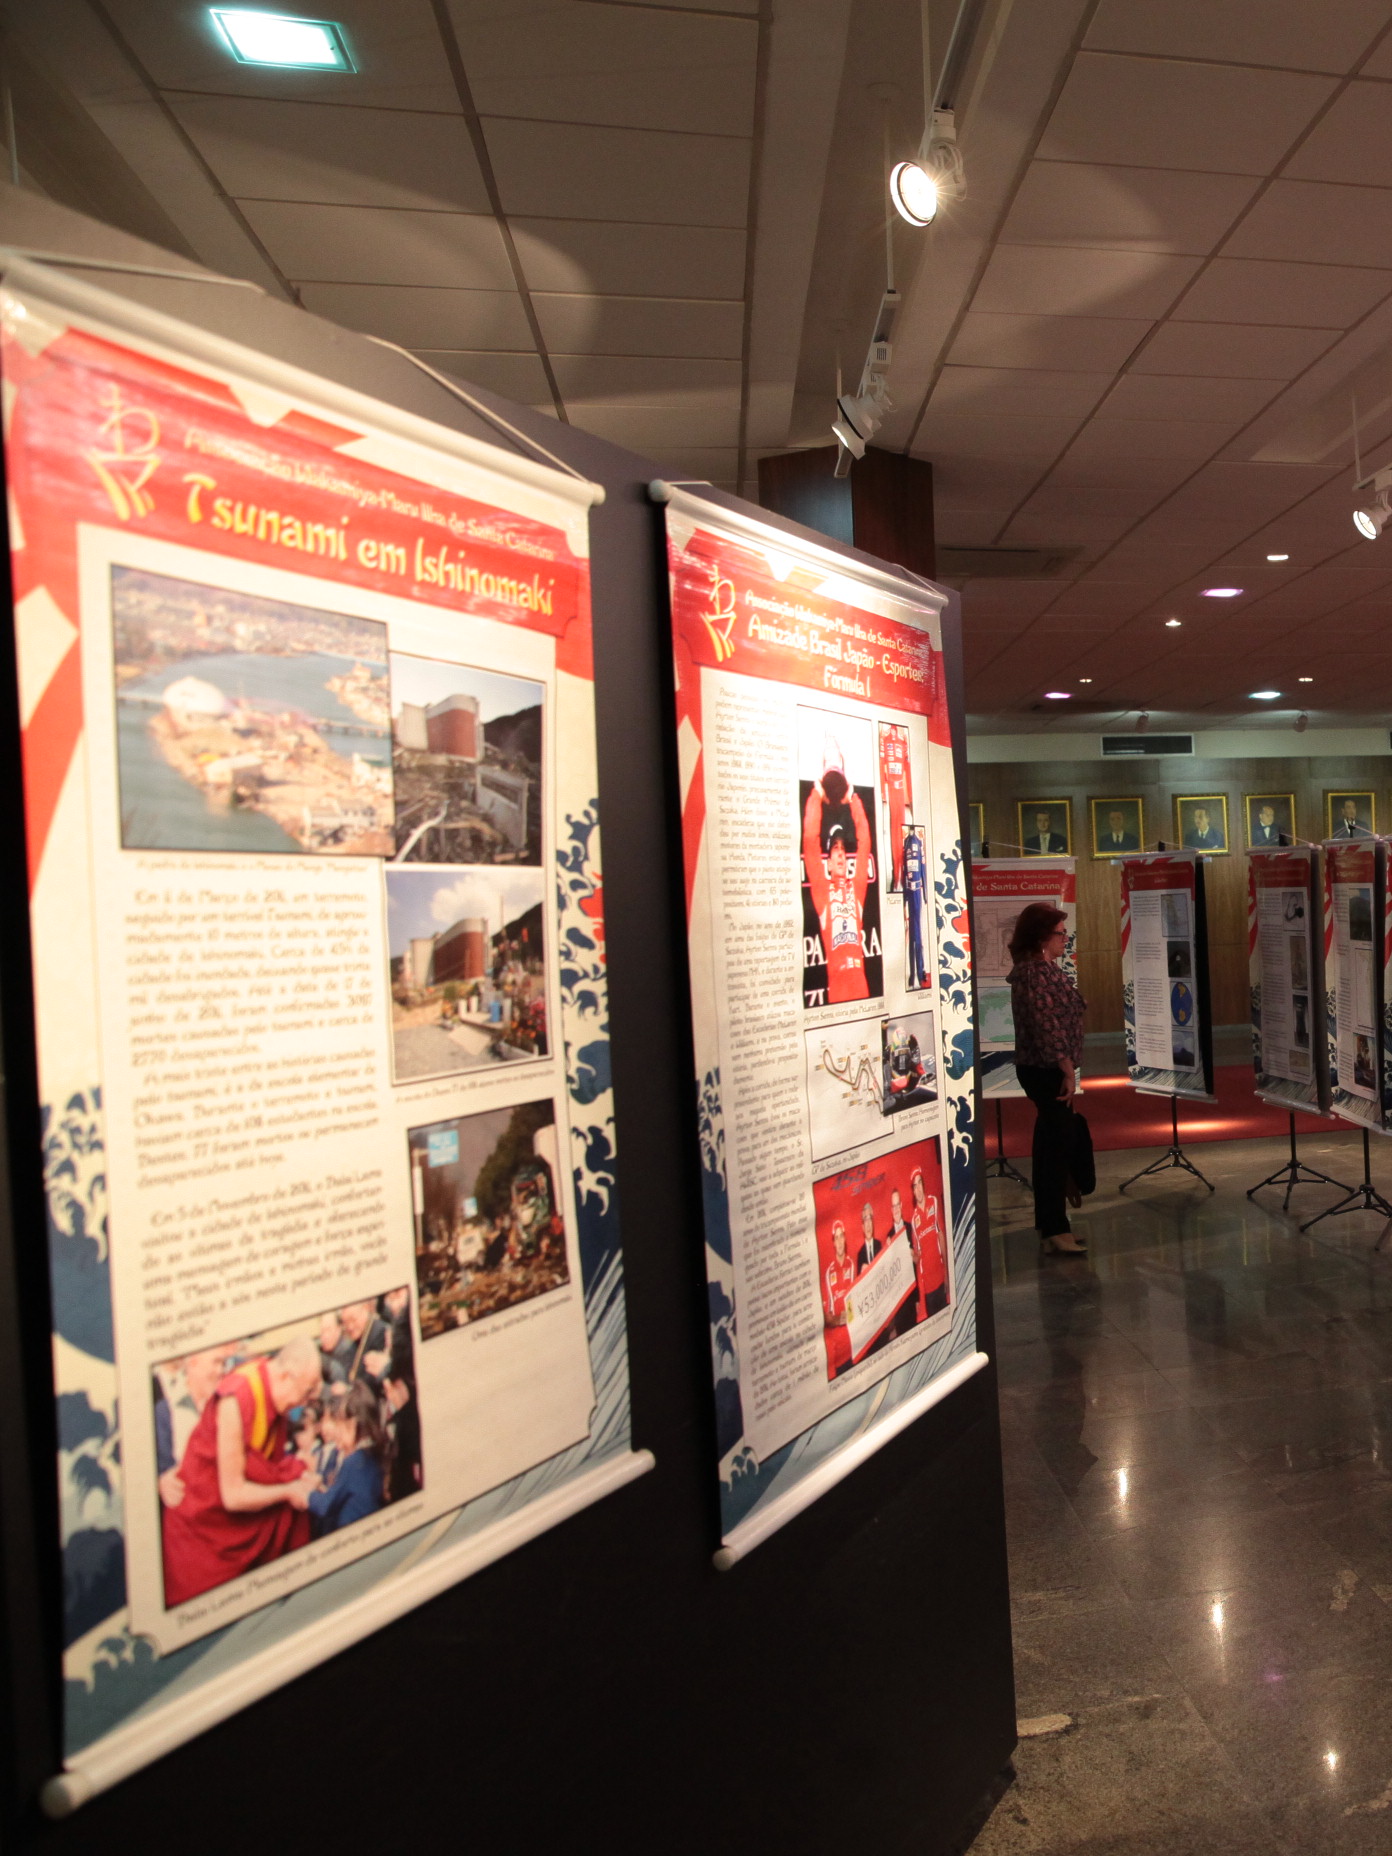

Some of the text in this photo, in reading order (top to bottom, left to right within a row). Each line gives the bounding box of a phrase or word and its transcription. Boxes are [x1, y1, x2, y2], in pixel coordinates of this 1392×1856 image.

[183, 473, 555, 617] Tsunami em Ishinomaki
[467, 519, 505, 545] Santa
[748, 613, 808, 651] Amizade
[810, 630, 842, 661] Brasil
[844, 641, 874, 672] Japão
[867, 629, 877, 644] de
[877, 633, 896, 650] Santa
[824, 665, 865, 697] Fórmula
[976, 881, 1061, 891] de Santa Catarina
